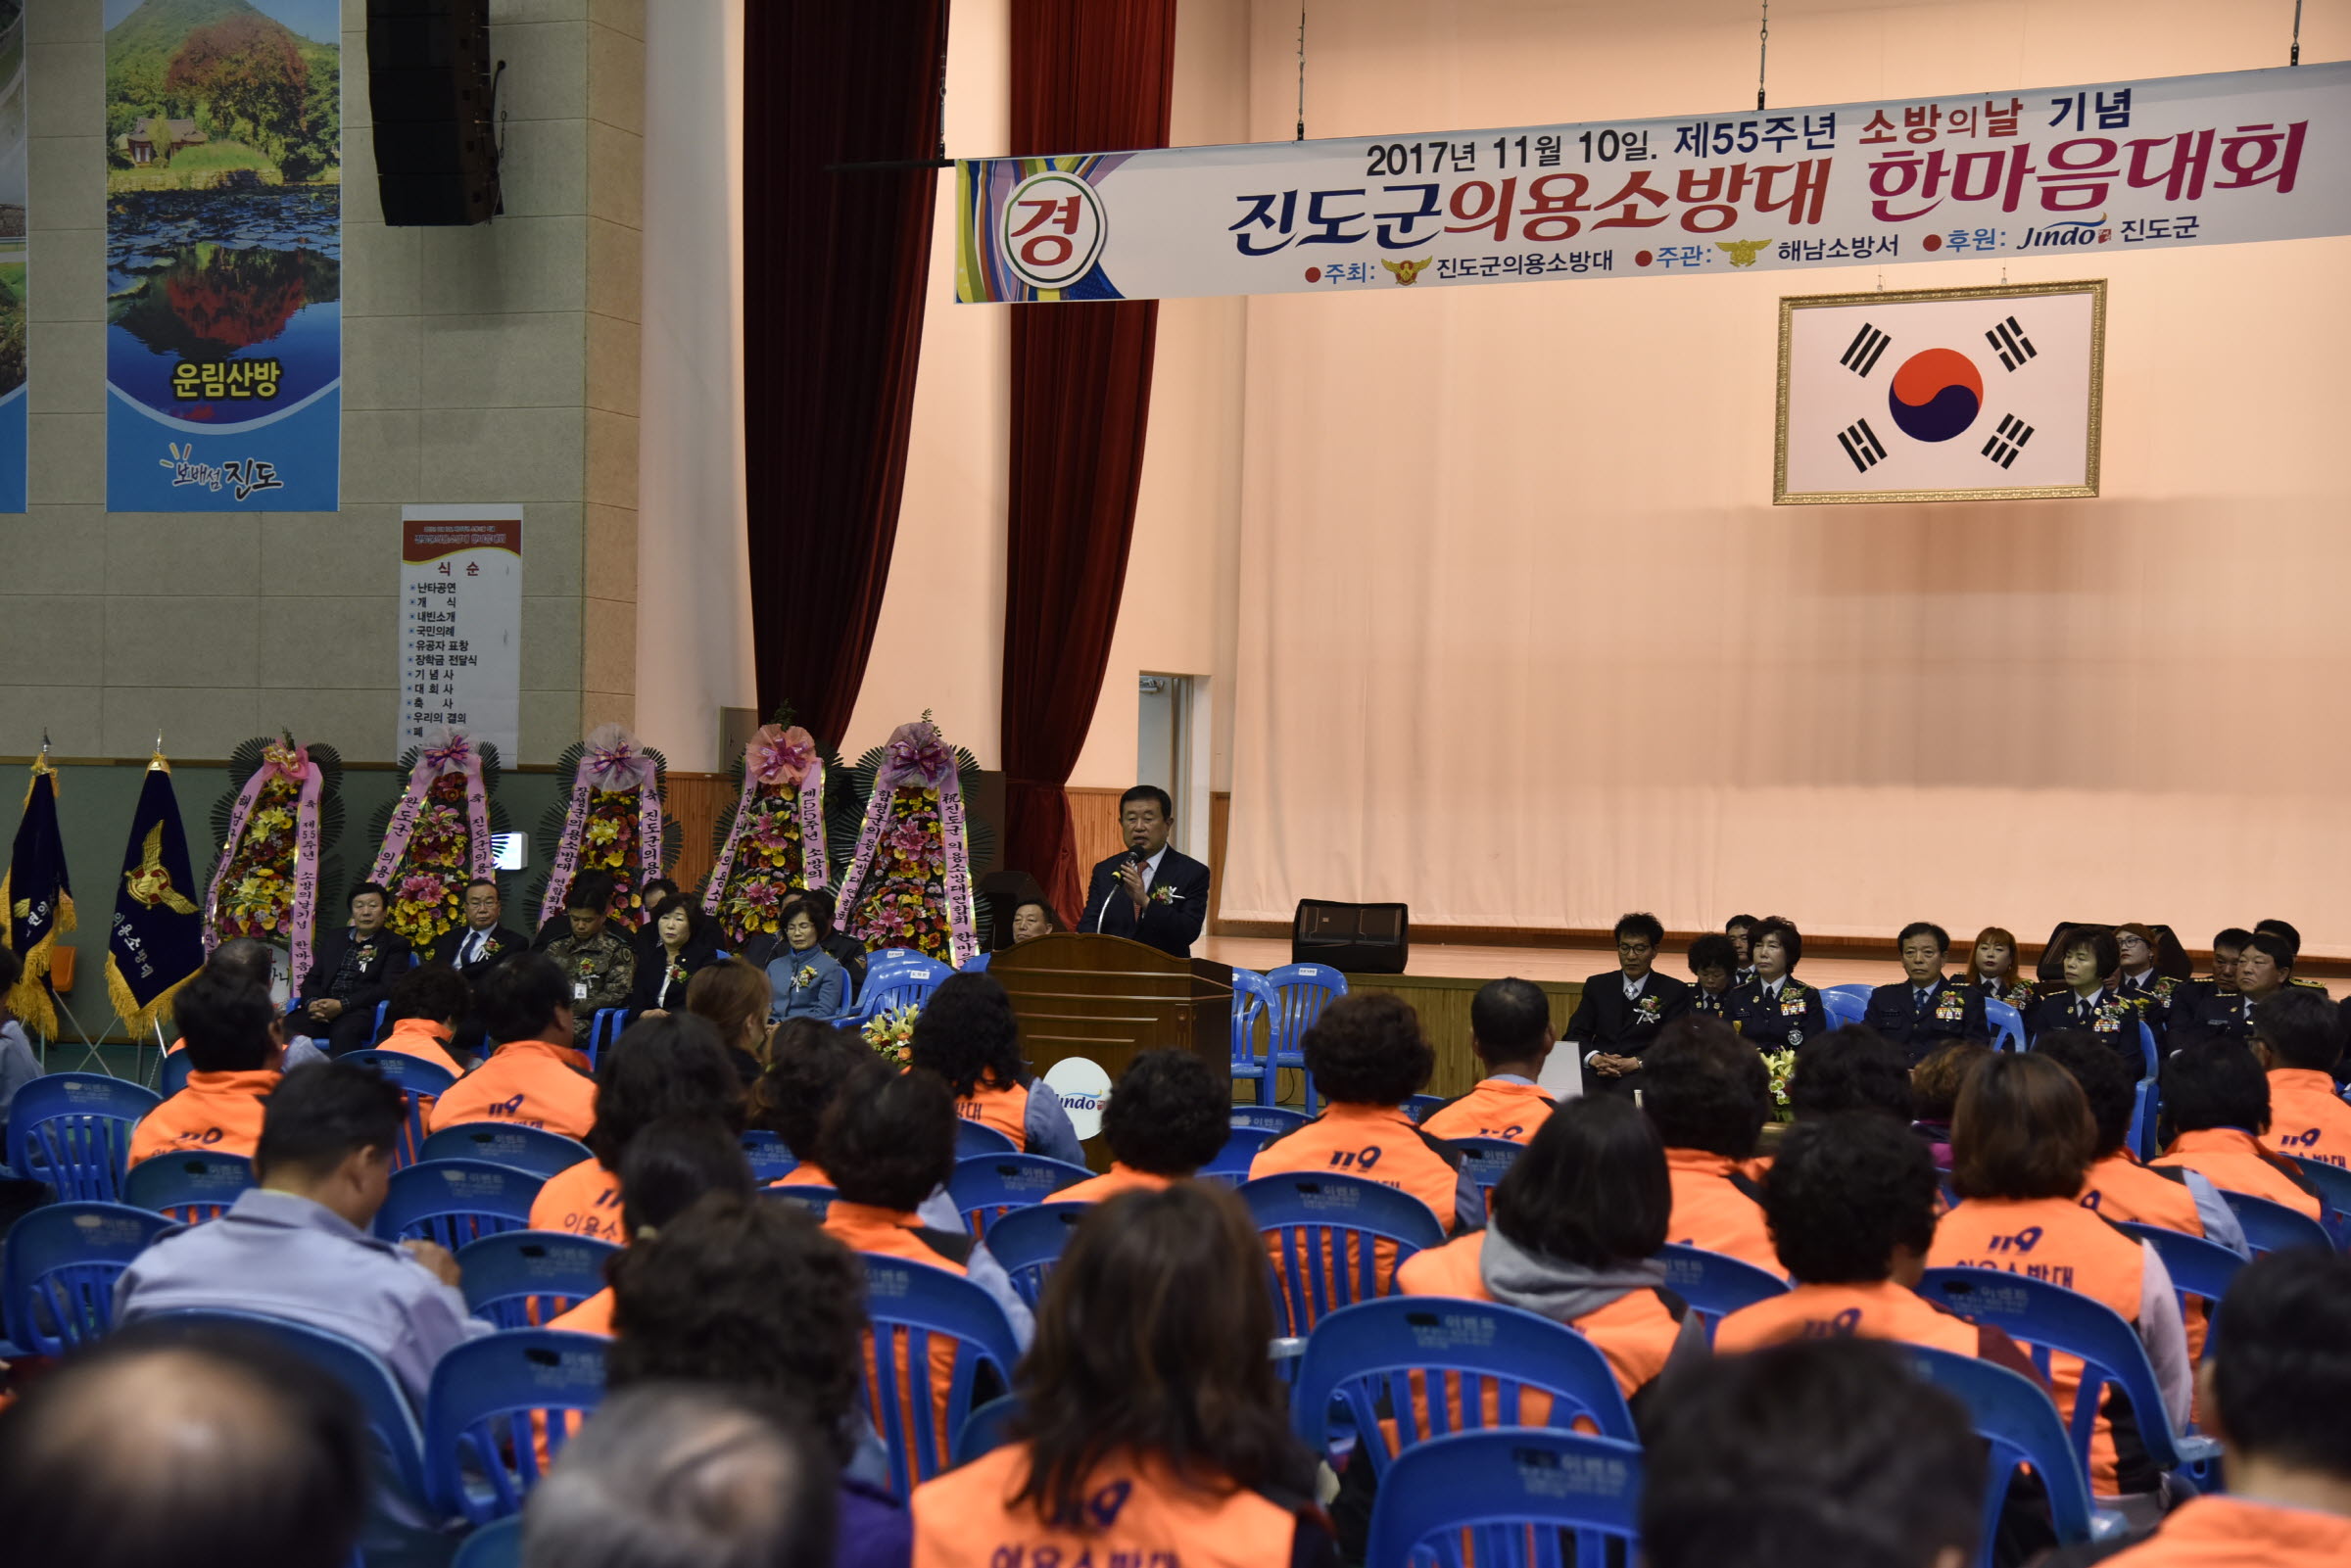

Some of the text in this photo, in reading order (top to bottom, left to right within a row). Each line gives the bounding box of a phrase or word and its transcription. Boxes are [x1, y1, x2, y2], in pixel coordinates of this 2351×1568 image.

[1367, 87, 2133, 176] 2017년 11월 10일. 제55주년 소방의날 기념
[1227, 119, 2310, 257] 진도군의용소방대 한마음대회
[1010, 194, 1082, 266] 경
[1324, 261, 1375, 285] 주최:
[1436, 249, 1614, 281] 진도군의용소방대
[1656, 245, 1712, 269] 주관:
[1778, 233, 1899, 262] 해남소방서
[1945, 228, 2006, 253] 후원:
[2120, 215, 2200, 244] 진도군
[172, 360, 281, 398] 운림산방
[172, 458, 283, 500] 보배섬 진도
[417, 582, 456, 594] 난타공연
[417, 611, 456, 623] 내빈소개
[416, 625, 456, 638] 국민의례
[415, 640, 469, 652] 유공자 표창
[415, 654, 478, 667] 장학금 전달식
[413, 711, 467, 725] 우리의 결의
[392, 795, 419, 837] 완도군
[489, 1094, 524, 1116] 119
[2281, 1127, 2322, 1147] 119
[1329, 1145, 1382, 1169] 119
[1988, 1225, 2043, 1253] 119
